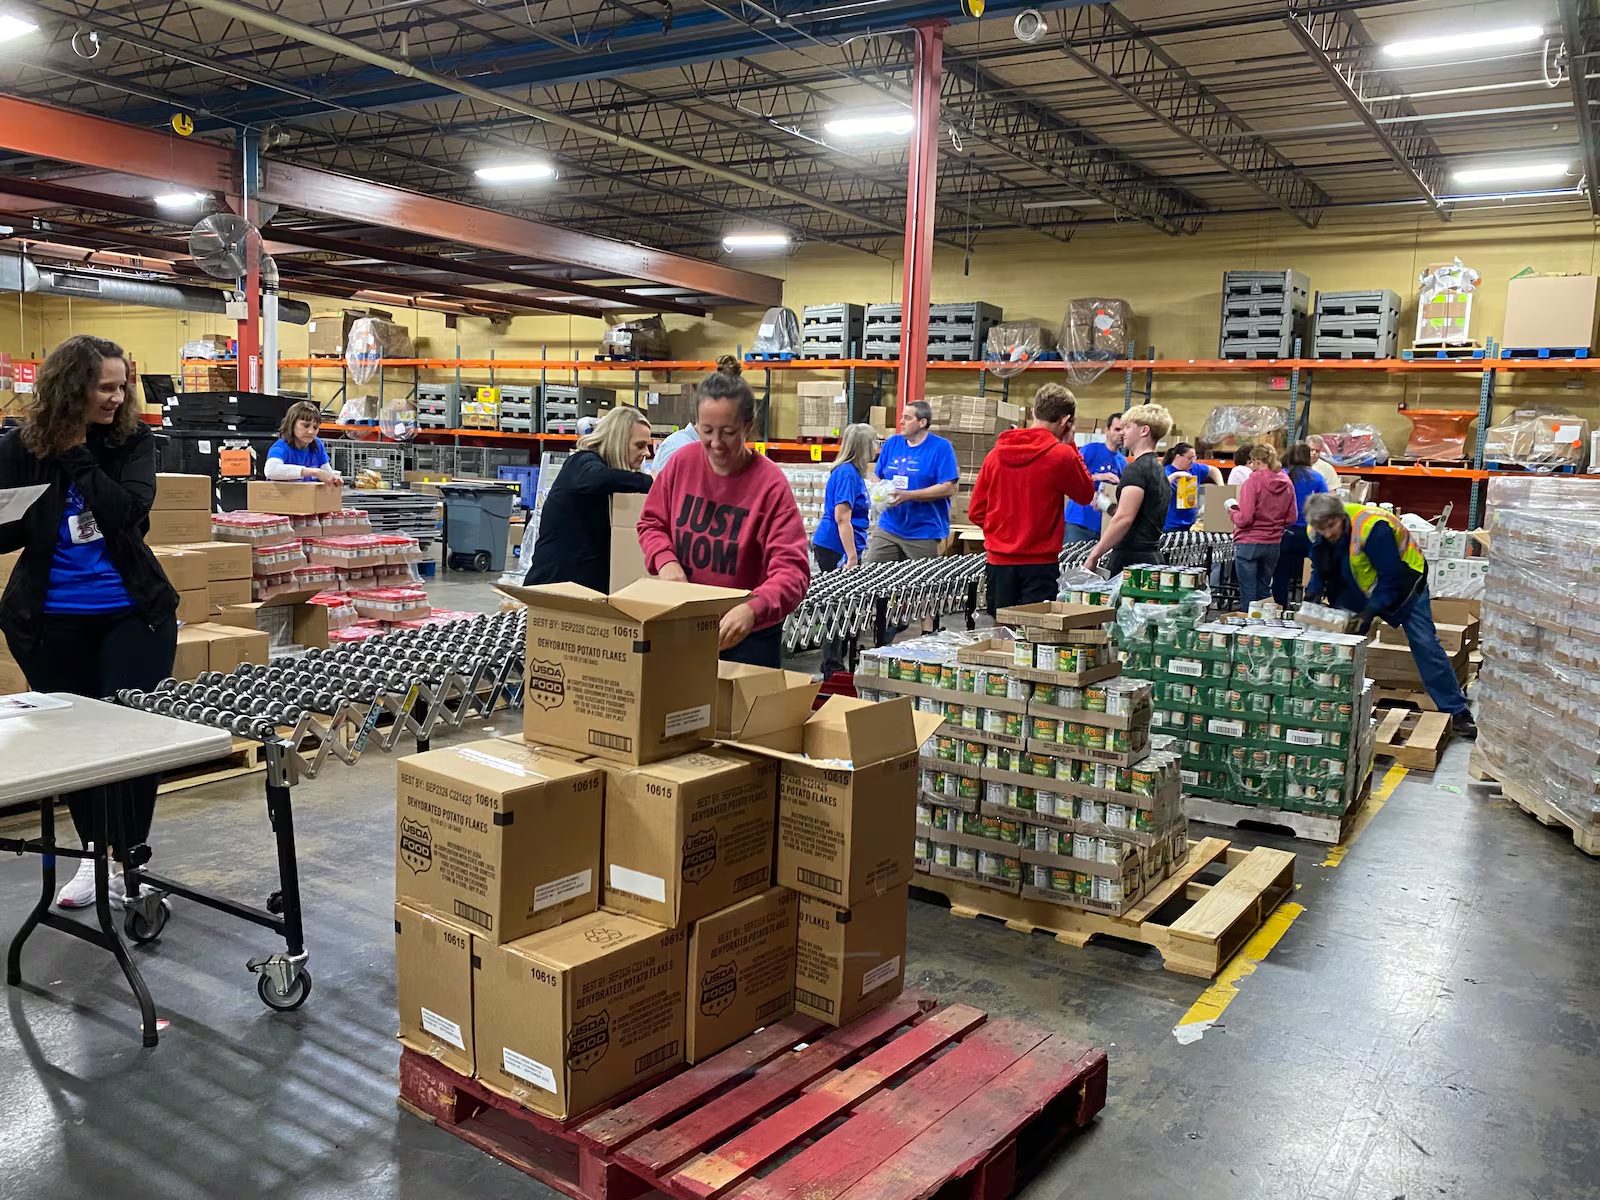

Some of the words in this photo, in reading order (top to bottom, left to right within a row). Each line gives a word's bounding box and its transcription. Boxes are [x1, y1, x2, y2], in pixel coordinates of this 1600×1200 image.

[676, 494, 749, 540] JUST
[676, 528, 738, 576] MOM
[533, 616, 547, 628] BEST
[549, 619, 560, 630] BY:
[613, 626, 638, 639] 10615
[537, 637, 575, 653] DEHYDRATED
[577, 644, 600, 657] POTATO
[602, 648, 626, 662] FLAKES
[532, 664, 561, 677] USDA
[532, 678, 561, 692] FOOD
[401, 772, 414, 786] BEST
[415, 778, 424, 789] BY:
[572, 777, 599, 792] 10615
[824, 769, 849, 786] 10615
[645, 783, 672, 798] 10615
[786, 784, 810, 800] POTATO
[812, 791, 836, 807] FLAKES
[476, 793, 498, 810] 10615
[407, 795, 440, 817] DEHYDRATED
[442, 808, 463, 825] POTATO
[465, 816, 487, 833] FLAKES
[403, 823, 428, 840] USDA
[403, 838, 429, 856] FOOD
[685, 832, 714, 850] USDA
[685, 848, 713, 866] FOOD
[805, 913, 829, 929] FLAKES
[443, 931, 465, 950] 10615
[661, 931, 684, 947] 10615
[710, 935, 746, 959] DEHYDRATED
[748, 925, 768, 943] POTATO
[769, 916, 788, 933] FLAKES
[531, 968, 557, 987] 10615
[576, 982, 621, 1010] DEHYDRATED
[623, 970, 648, 989] POTATO
[649, 959, 672, 978] FLAKES
[704, 966, 733, 986] USDA
[704, 981, 733, 1002] FOOD
